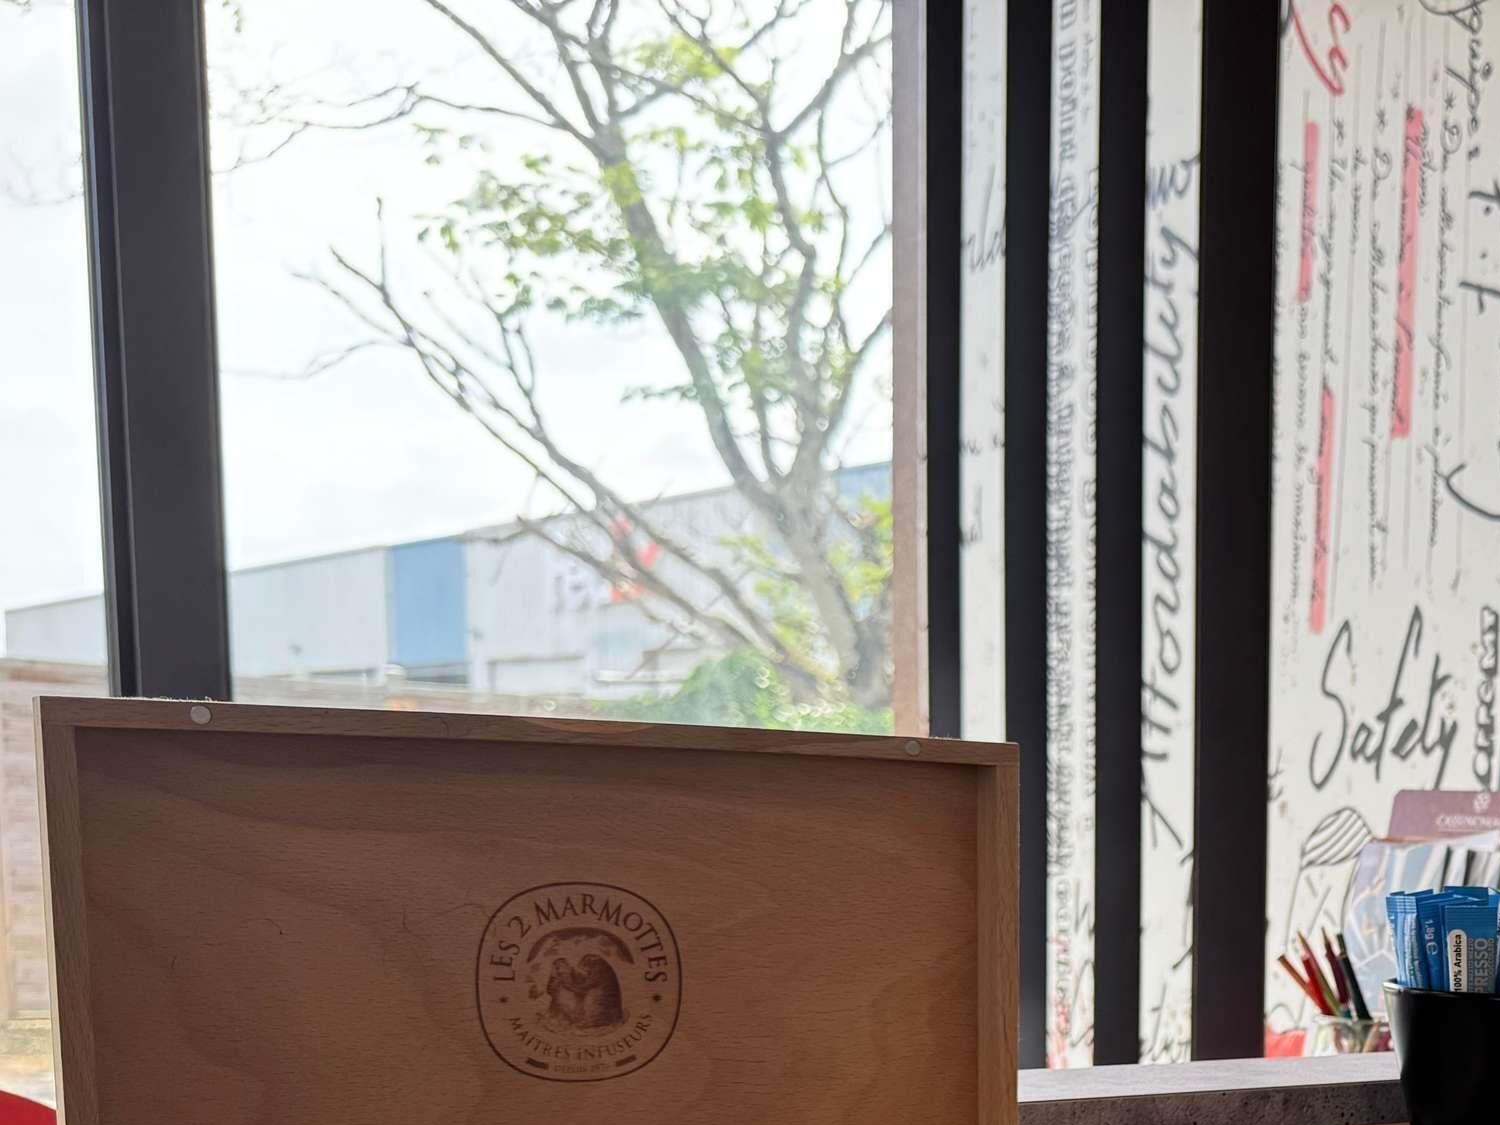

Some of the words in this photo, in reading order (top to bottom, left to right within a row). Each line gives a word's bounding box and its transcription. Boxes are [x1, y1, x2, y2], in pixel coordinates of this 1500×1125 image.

[1310, 605, 1457, 790] Safety
[489, 939, 520, 982] LES
[508, 915, 532, 939] 2
[533, 893, 669, 984] MARMOTTES
[1453, 934, 1463, 968] Arabica
[573, 1013, 655, 1061] INFUSEURS
